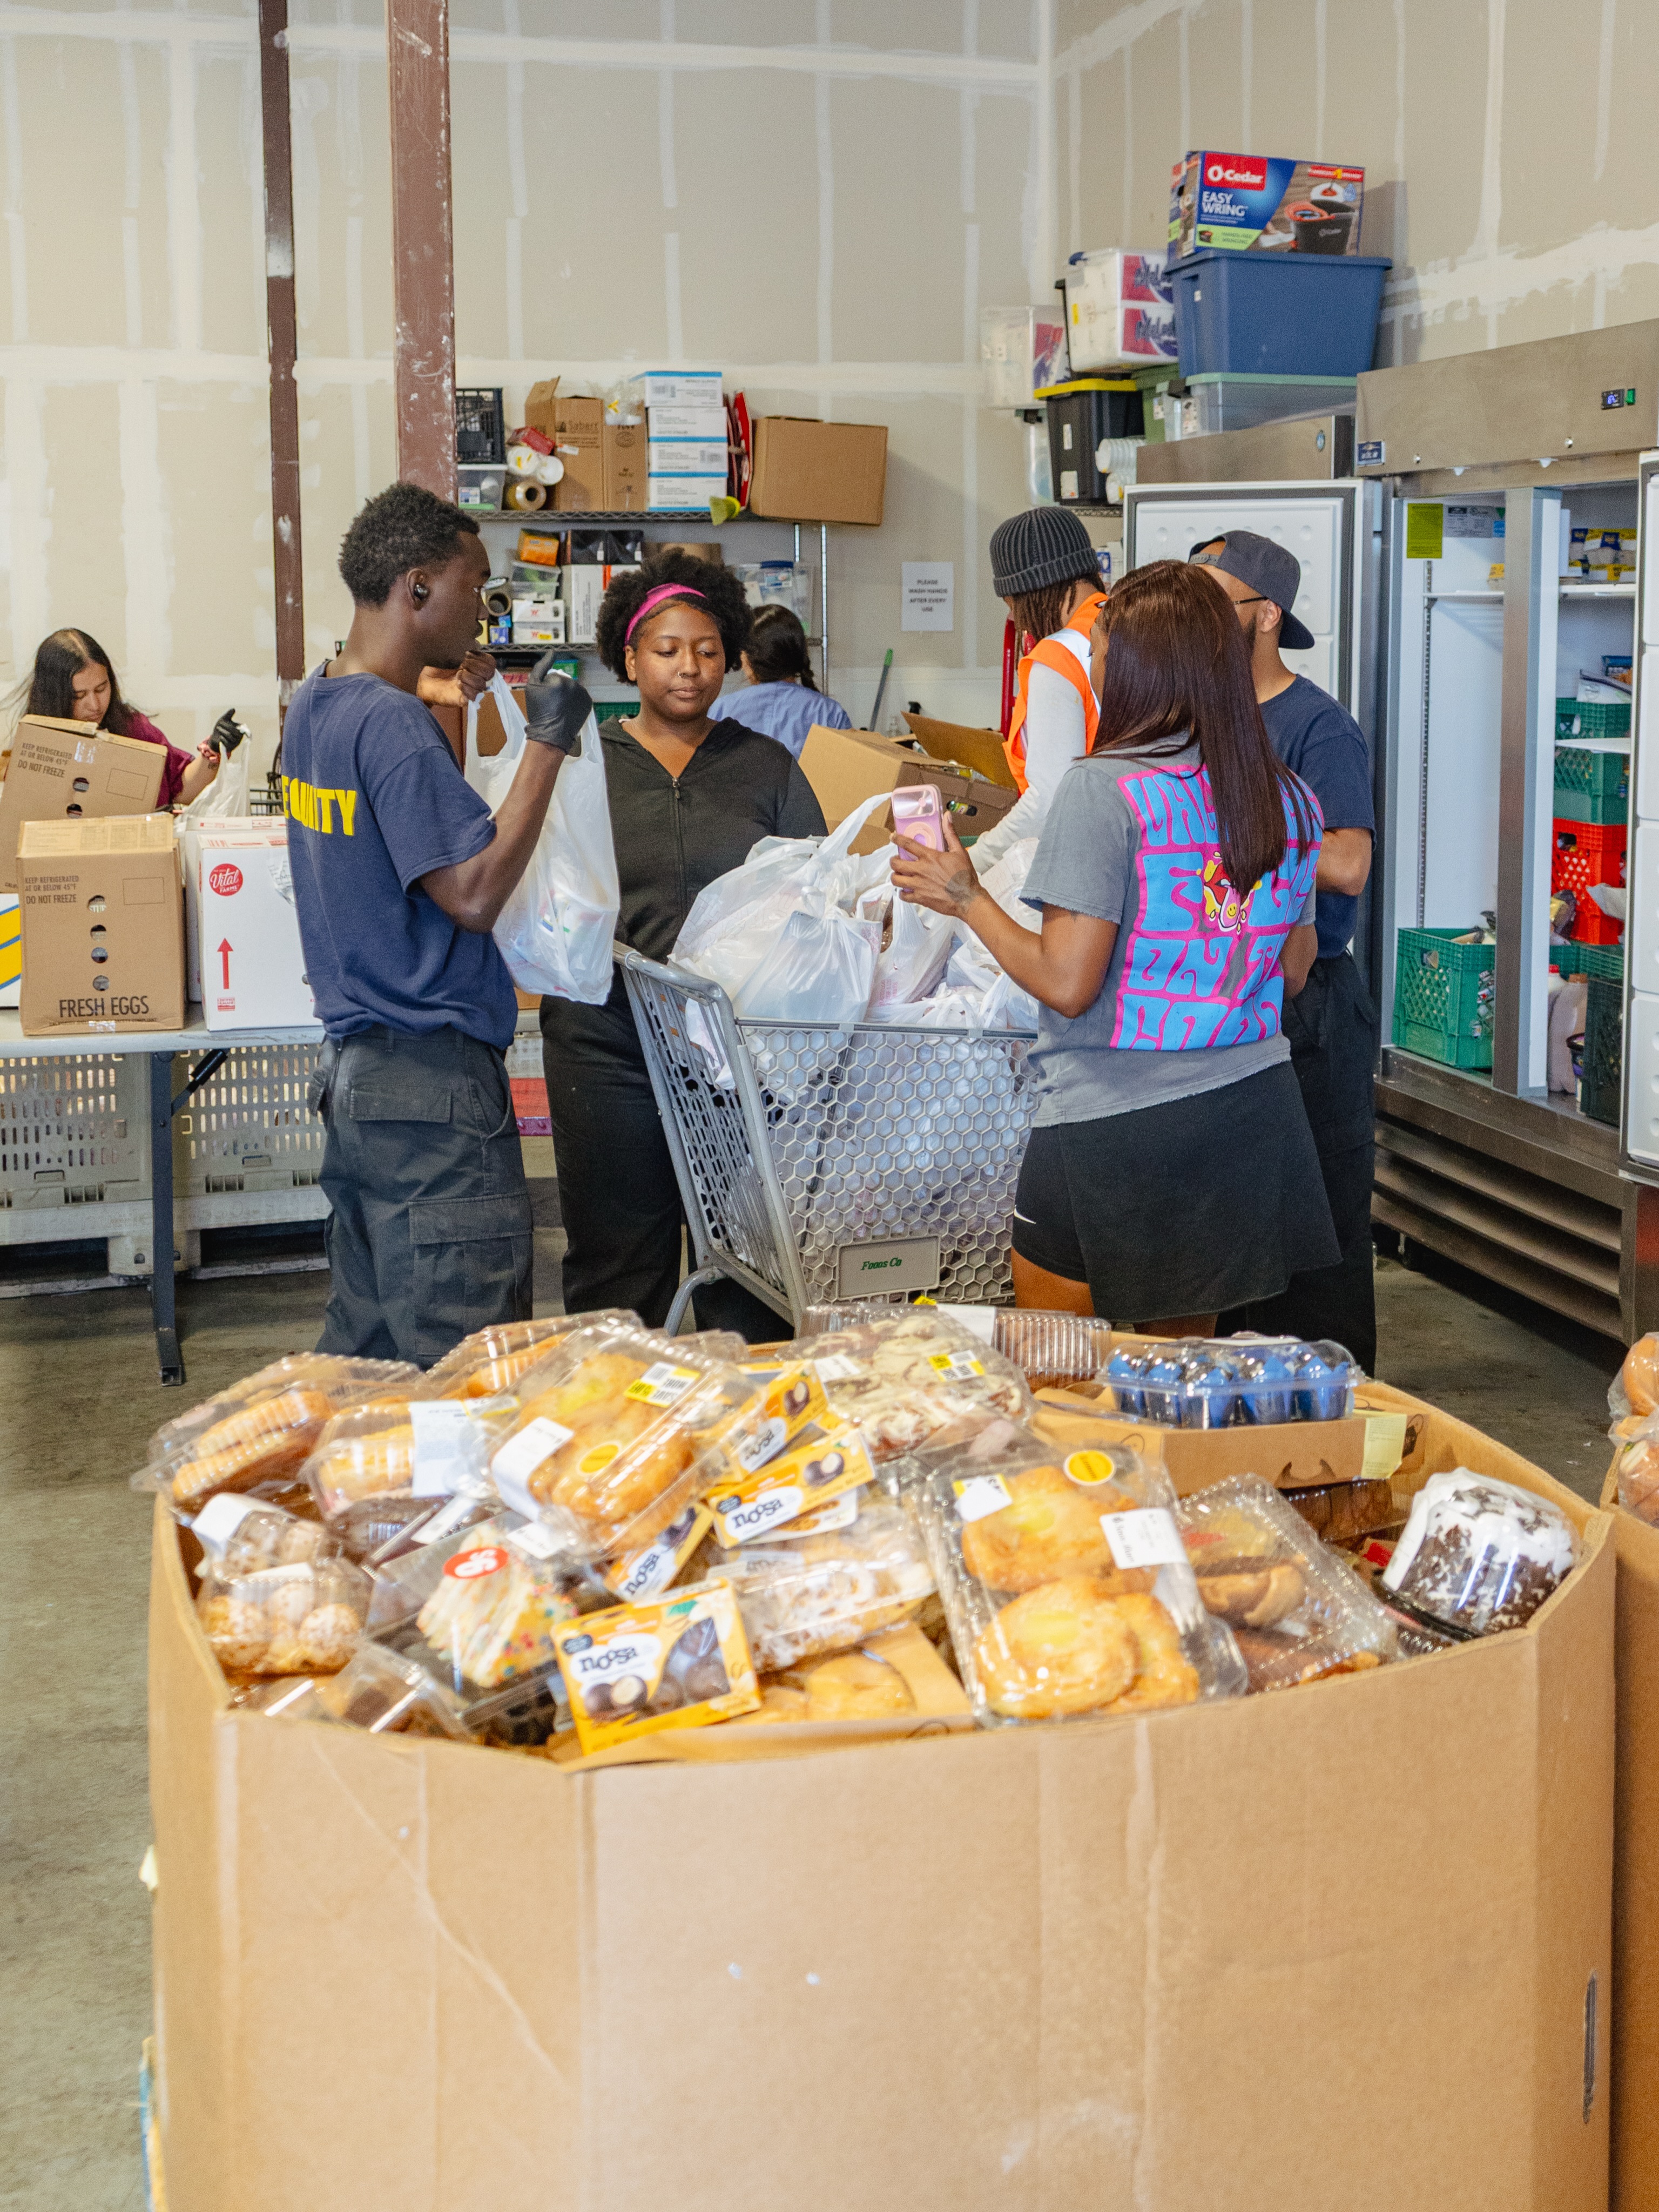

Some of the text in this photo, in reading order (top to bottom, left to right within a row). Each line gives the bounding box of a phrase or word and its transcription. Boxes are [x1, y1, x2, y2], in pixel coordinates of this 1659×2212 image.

[1203, 191, 1233, 205] EASY
[36, 746, 72, 759] REFRIGERATED
[37, 753, 54, 763] BELOW
[17, 759, 65, 778] DO NOT FREEZE
[281, 775, 356, 836] EQUITY
[40, 875, 79, 884] REFRIGERATED
[210, 868, 239, 889] Vital
[26, 894, 77, 905] DO NOT FREEZE
[219, 886, 238, 894] FARMS
[1128, 936, 1233, 997] ON
[59, 995, 150, 1018] FRESH EGGS
[732, 1498, 784, 1529] noosa
[625, 1553, 660, 1596] noosa
[579, 1647, 639, 1673] noosa
